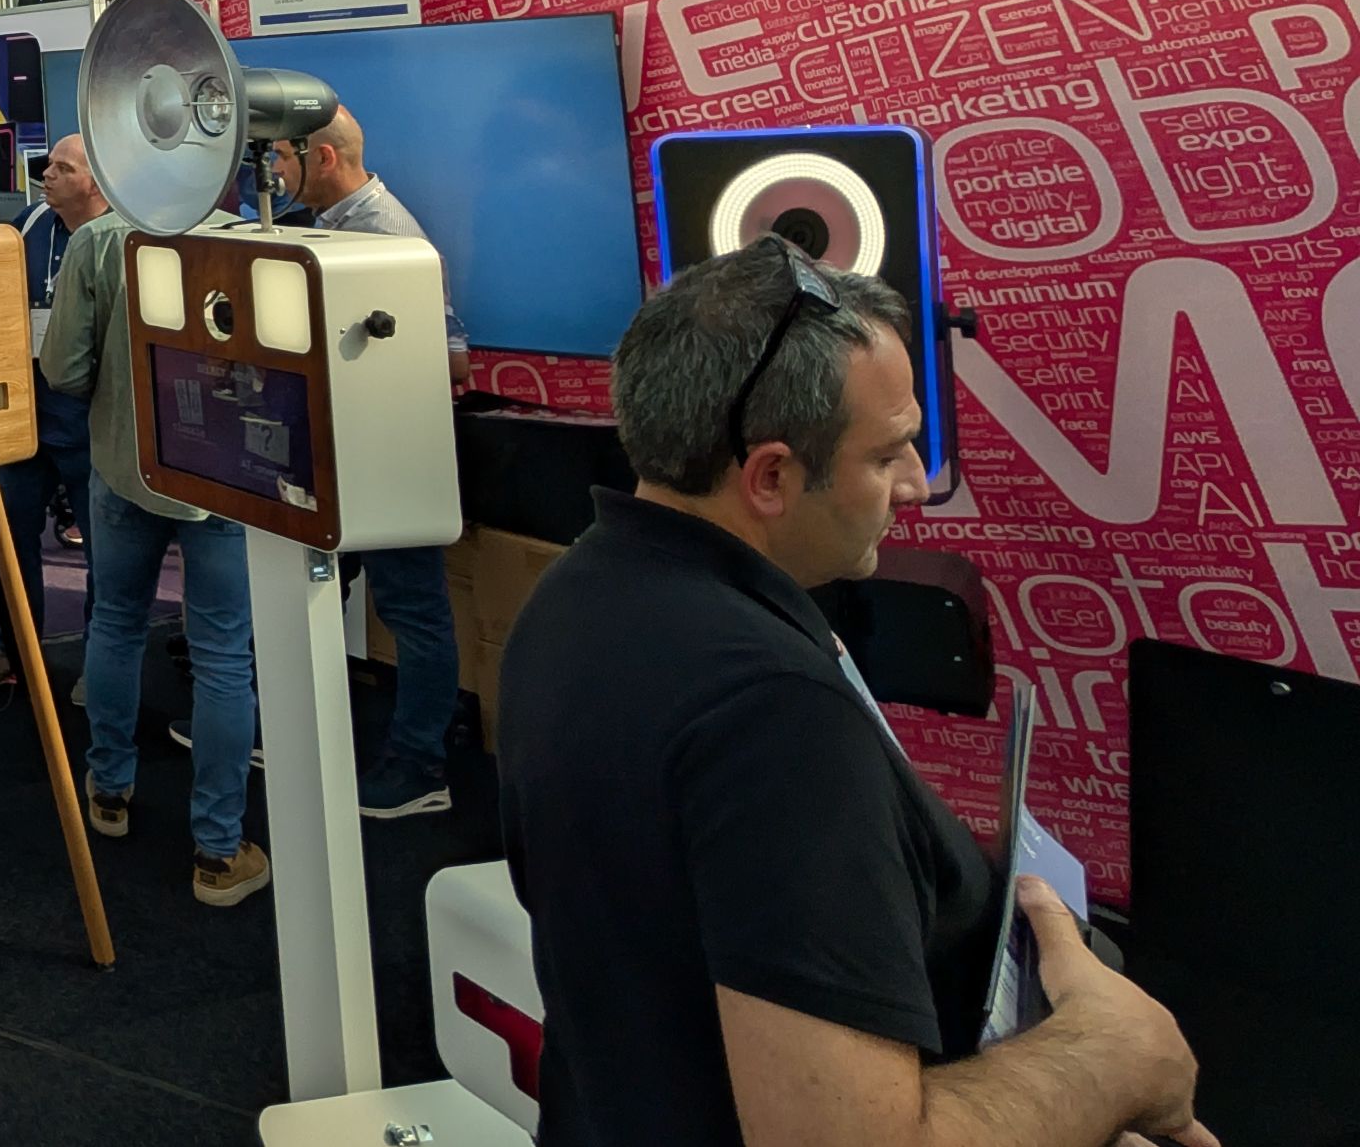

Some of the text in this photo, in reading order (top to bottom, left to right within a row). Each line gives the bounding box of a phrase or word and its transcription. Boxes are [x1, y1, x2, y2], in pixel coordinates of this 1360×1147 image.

[823, 1, 847, 14] lens
[999, 4, 1054, 22] sensor
[762, 30, 797, 47] supply
[913, 21, 953, 38] image
[879, 36, 900, 48] ISO
[1004, 35, 1059, 52] thermal
[1142, 27, 1250, 54] automation
[719, 43, 745, 58] CPU
[850, 45, 870, 60] ring
[711, 47, 776, 74] media
[646, 65, 677, 78] email
[803, 62, 841, 79] latency
[957, 65, 1056, 91] performance
[1127, 48, 1237, 97] print
[1238, 58, 1270, 83] ai
[643, 80, 682, 94] sensor
[804, 74, 845, 92] monitor
[872, 81, 944, 113] instant
[887, 78, 1100, 126] marketing
[1289, 90, 1335, 105] face
[774, 101, 805, 118] power
[806, 100, 849, 120] backend
[1161, 104, 1251, 134] selfie
[1178, 125, 1272, 151] expo
[969, 136, 1057, 167] printer
[953, 164, 1086, 199] portable
[1173, 152, 1286, 199] light
[1264, 183, 1311, 200] CPU
[964, 190, 1074, 218] mobility
[1195, 205, 1278, 224] assembly
[991, 210, 1088, 243] digital
[1129, 227, 1174, 242] SQL
[1088, 249, 1156, 264] custom
[1249, 236, 1342, 269] parts
[975, 262, 1082, 281] development
[1246, 270, 1314, 285] backup
[953, 279, 1117, 309] aluminium
[1282, 286, 1318, 299] low
[983, 305, 1119, 336] premium
[1263, 307, 1313, 322] AWS
[991, 327, 1109, 353] security
[1271, 333, 1308, 348] ISO
[1017, 362, 1099, 387] selfie
[1176, 356, 1203, 374] AI
[1292, 357, 1331, 373] ring
[559, 379, 583, 389] RGB
[1291, 374, 1337, 388] Core
[1041, 388, 1110, 414] print
[1176, 379, 1211, 404] AI
[1302, 390, 1334, 416] ai
[1059, 418, 1098, 432] face
[1173, 430, 1222, 444] AWS
[959, 448, 1015, 461] display
[1173, 453, 1235, 476] API
[968, 473, 1046, 486] technical
[982, 495, 1072, 518] future
[1198, 481, 1265, 527] AI
[890, 518, 911, 540] ai
[915, 520, 1096, 549] processing
[1101, 527, 1256, 559] rendering
[1139, 563, 1254, 582] compatibility
[1213, 596, 1259, 611] driver
[1039, 605, 1108, 628] user
[1204, 617, 1271, 636] beauty
[1062, 825, 1094, 838] LAN
